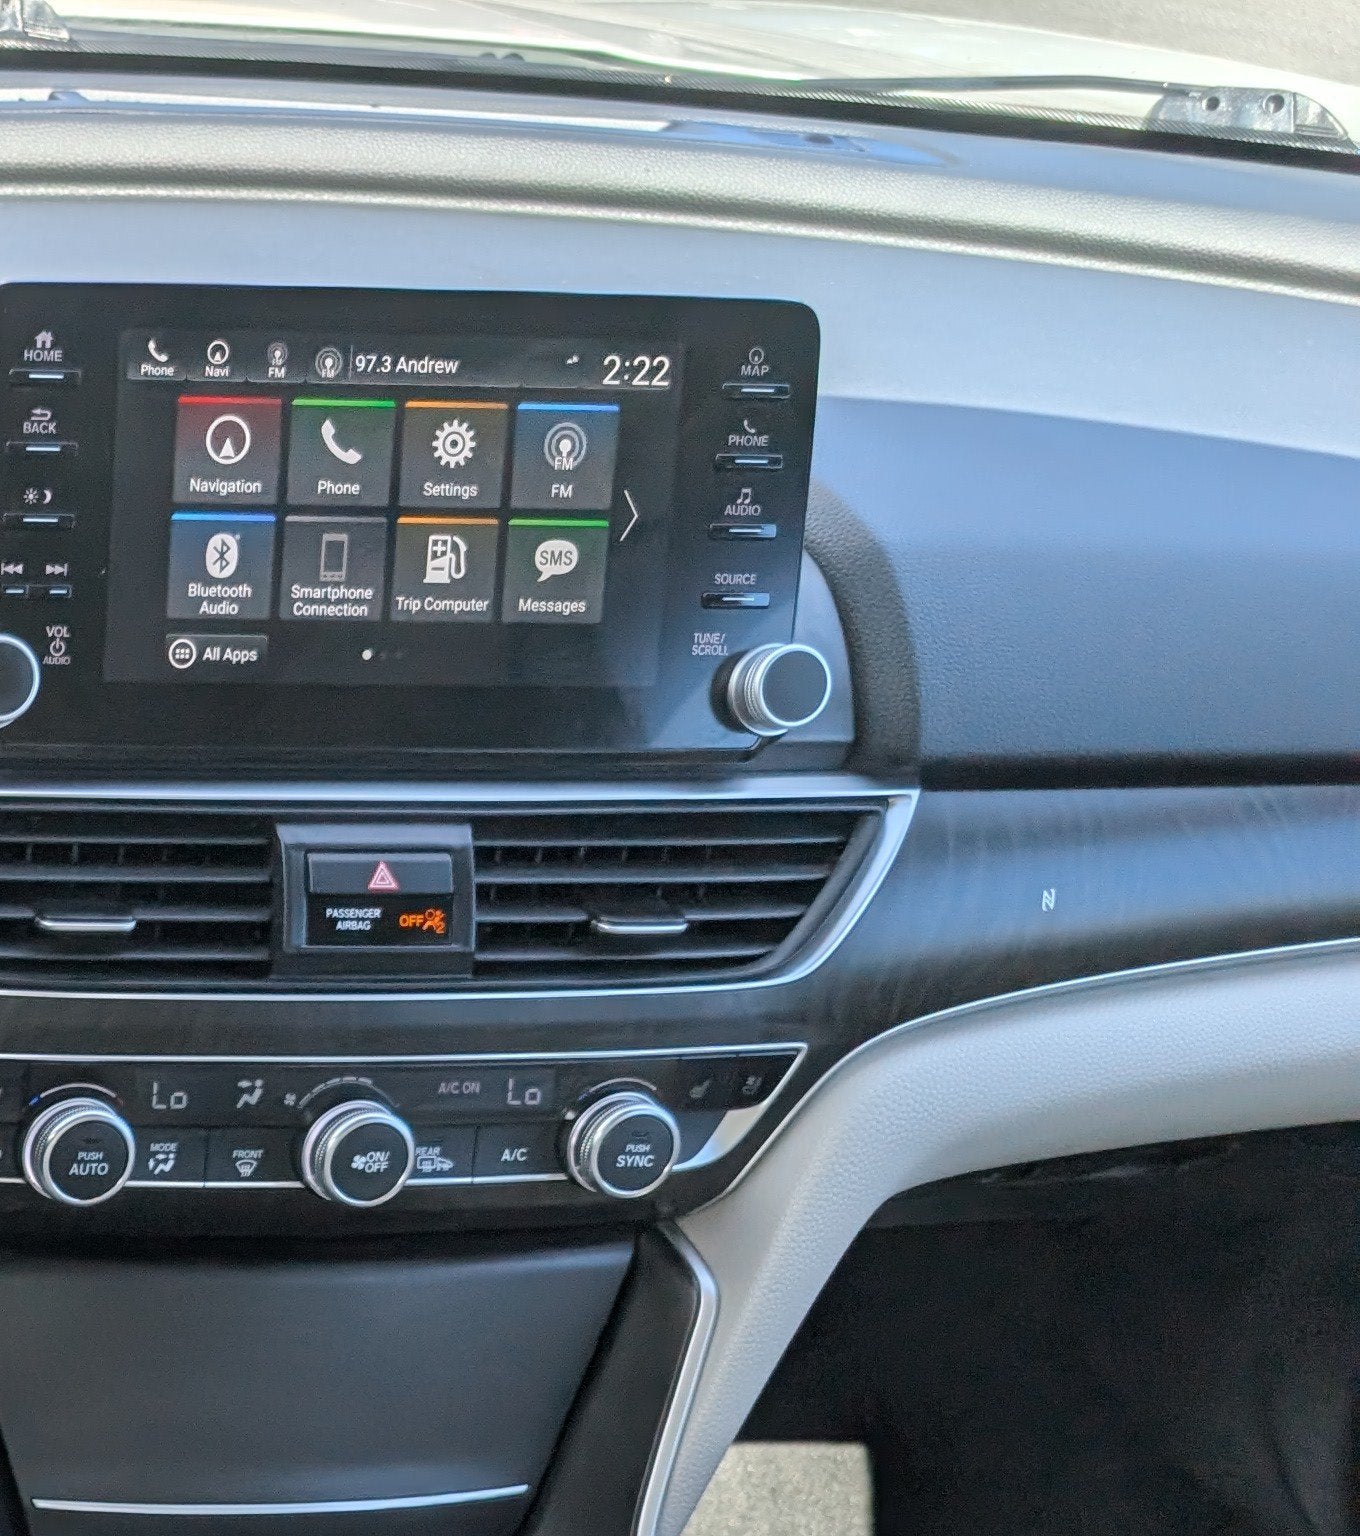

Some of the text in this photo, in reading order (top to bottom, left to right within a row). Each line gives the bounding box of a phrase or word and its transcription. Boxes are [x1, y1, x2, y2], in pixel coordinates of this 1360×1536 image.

[23, 350, 63, 362] HOME
[140, 363, 174, 377] Phone
[205, 365, 230, 378] Navi
[355, 355, 460, 375] 97.3 Andrew
[601, 354, 671, 387] 2:22
[740, 365, 770, 377] MAP
[268, 366, 285, 379] FM
[23, 421, 57, 434] BACK
[728, 434, 769, 447] PHONE
[189, 478, 263, 496] Navigation
[317, 480, 361, 495] Phone
[423, 482, 479, 500] Settings
[551, 484, 573, 499] FM
[724, 504, 762, 516] AUDIO
[539, 550, 573, 567] SMS
[714, 573, 758, 585] SOURCE
[187, 583, 253, 598] Bluetooth
[290, 584, 374, 602] Smartphone
[198, 600, 239, 616] Audio
[292, 602, 368, 618] Connection
[395, 596, 489, 614] Trip Computer
[518, 598, 586, 616] Messages
[46, 625, 71, 639] VOL
[693, 632, 726, 645] TUNE/
[202, 647, 258, 664] All Apps
[691, 645, 729, 657] SCROLL
[42, 655, 72, 666] AUDIO
[325, 907, 382, 919] PASSENGER
[335, 920, 372, 931] AIRBAG
[398, 914, 424, 928] OFF
[437, 1081, 481, 1095] A/C ON
[149, 1142, 179, 1152] MODE
[415, 1146, 442, 1156] REAR
[624, 1143, 652, 1153] PUSH
[77, 1151, 104, 1162] PUSH
[232, 1149, 264, 1160] FRONT
[367, 1151, 391, 1162] ON/
[500, 1148, 528, 1162] A/C
[616, 1154, 655, 1168] SYNC
[68, 1162, 110, 1176] AUTO
[364, 1161, 389, 1174] OFF
